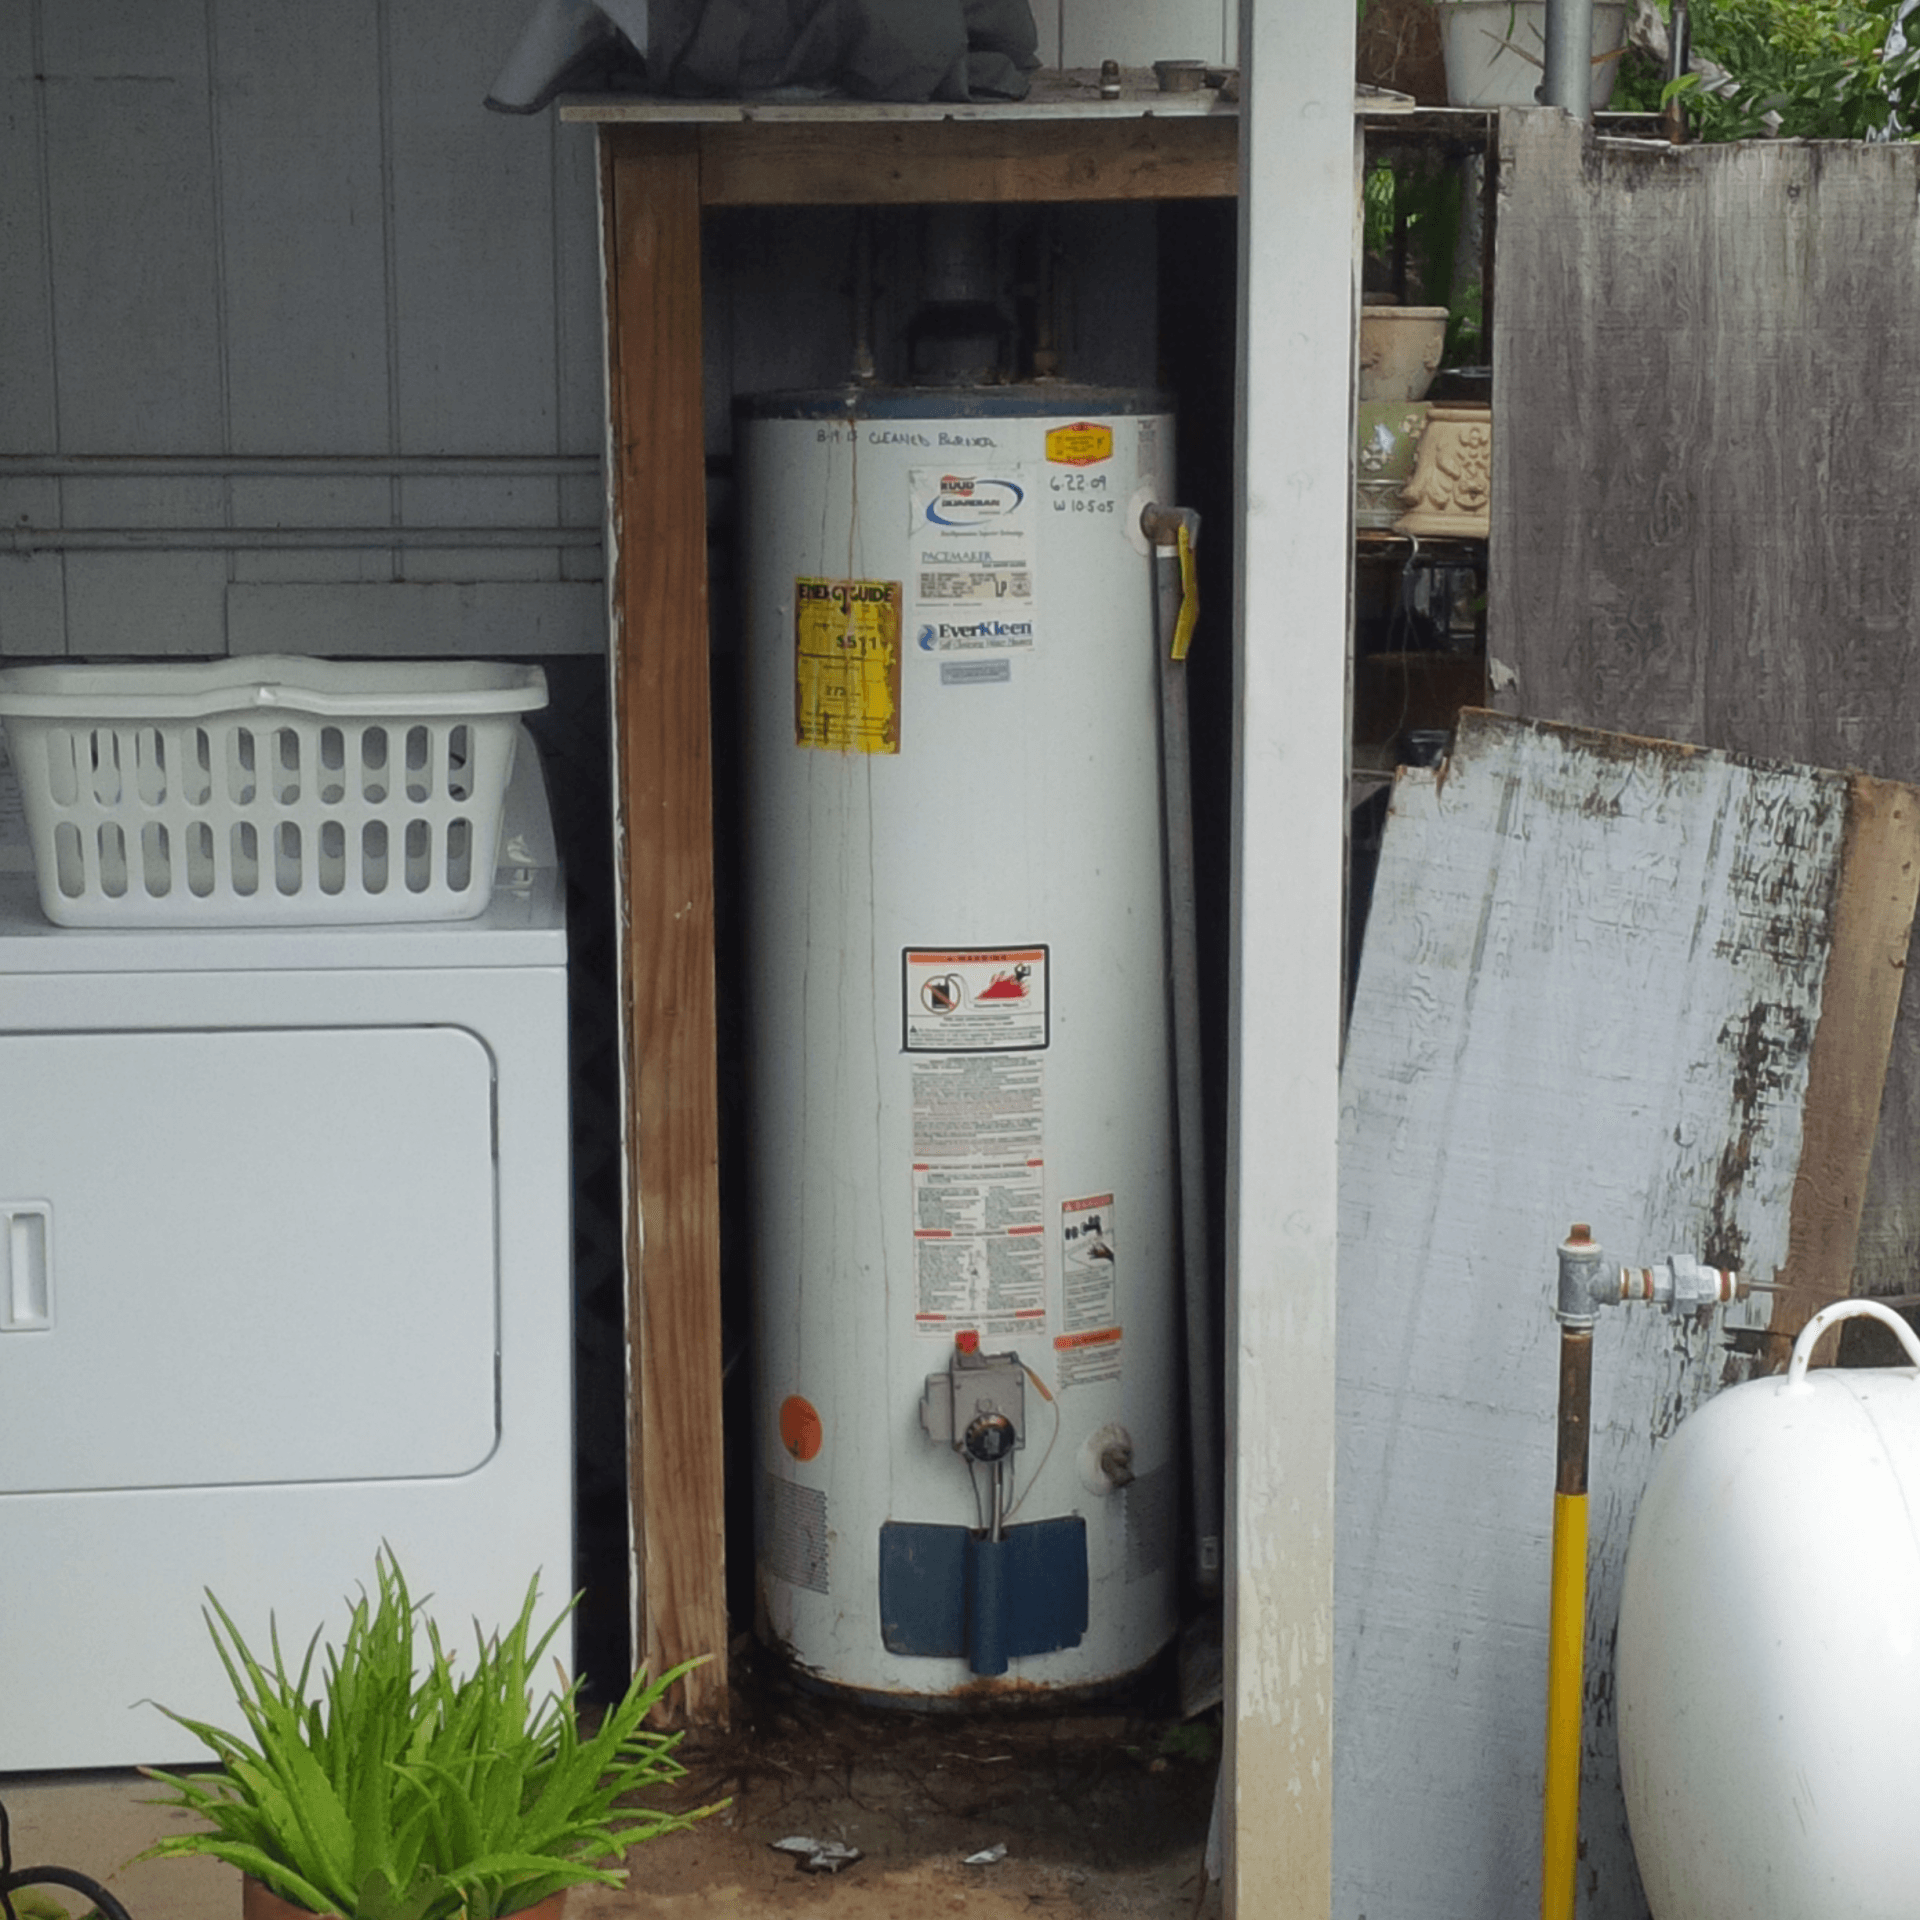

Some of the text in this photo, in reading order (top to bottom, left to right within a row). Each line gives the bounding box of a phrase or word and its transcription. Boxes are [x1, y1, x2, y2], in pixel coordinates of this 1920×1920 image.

[1053, 499, 1066, 512] W
[921, 551, 993, 563] PACEMAKER
[938, 620, 1032, 639] EverKleen
